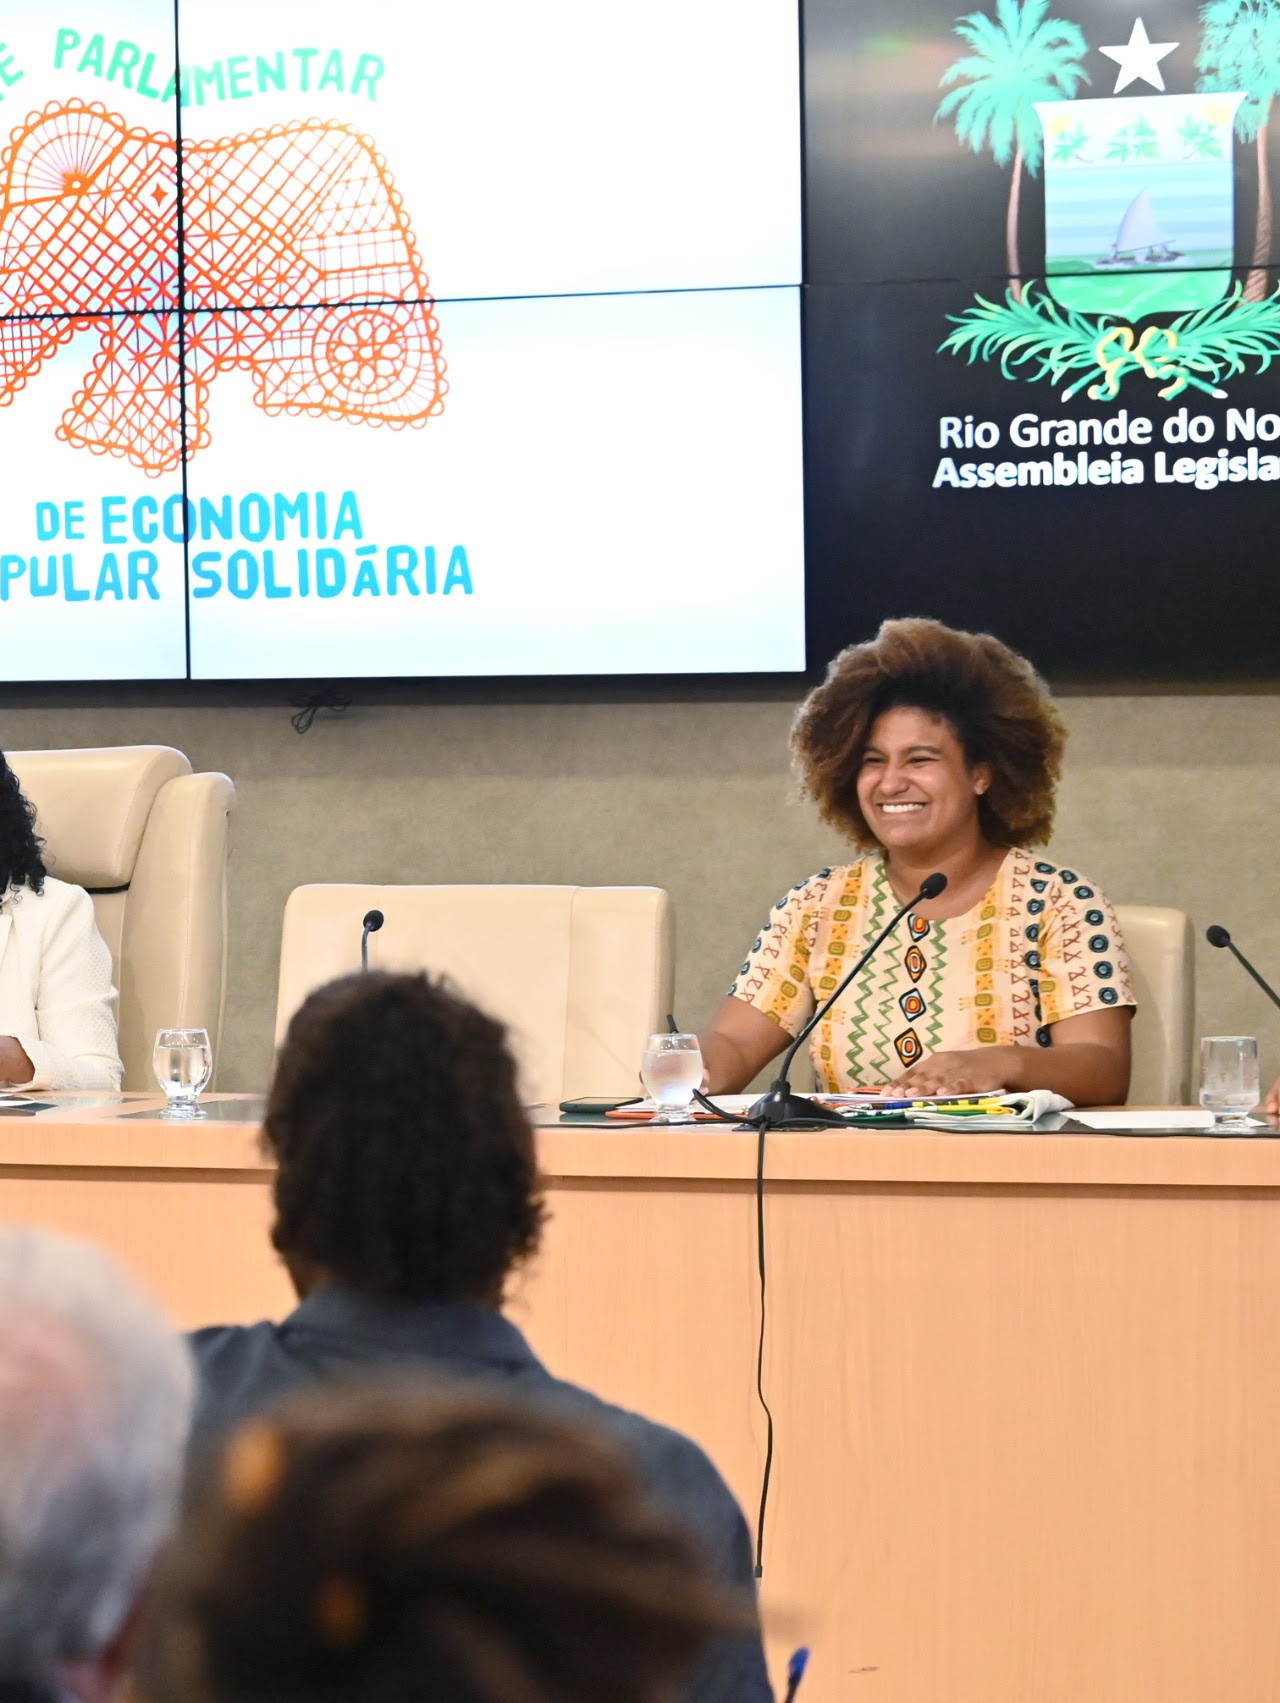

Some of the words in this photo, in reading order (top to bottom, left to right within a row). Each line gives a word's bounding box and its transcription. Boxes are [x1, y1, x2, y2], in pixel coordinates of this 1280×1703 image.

[53, 28, 385, 108] PARLAMENTAR
[939, 414, 1000, 449] Rio
[1009, 409, 1153, 448] Grande
[1162, 407, 1215, 443] do
[932, 451, 1145, 489] Assembleia
[1154, 447, 1280, 490] Legisla
[36, 500, 86, 542] DE
[101, 490, 364, 545] ECONOMIA
[191, 544, 474, 600] SOLIDÁRIA
